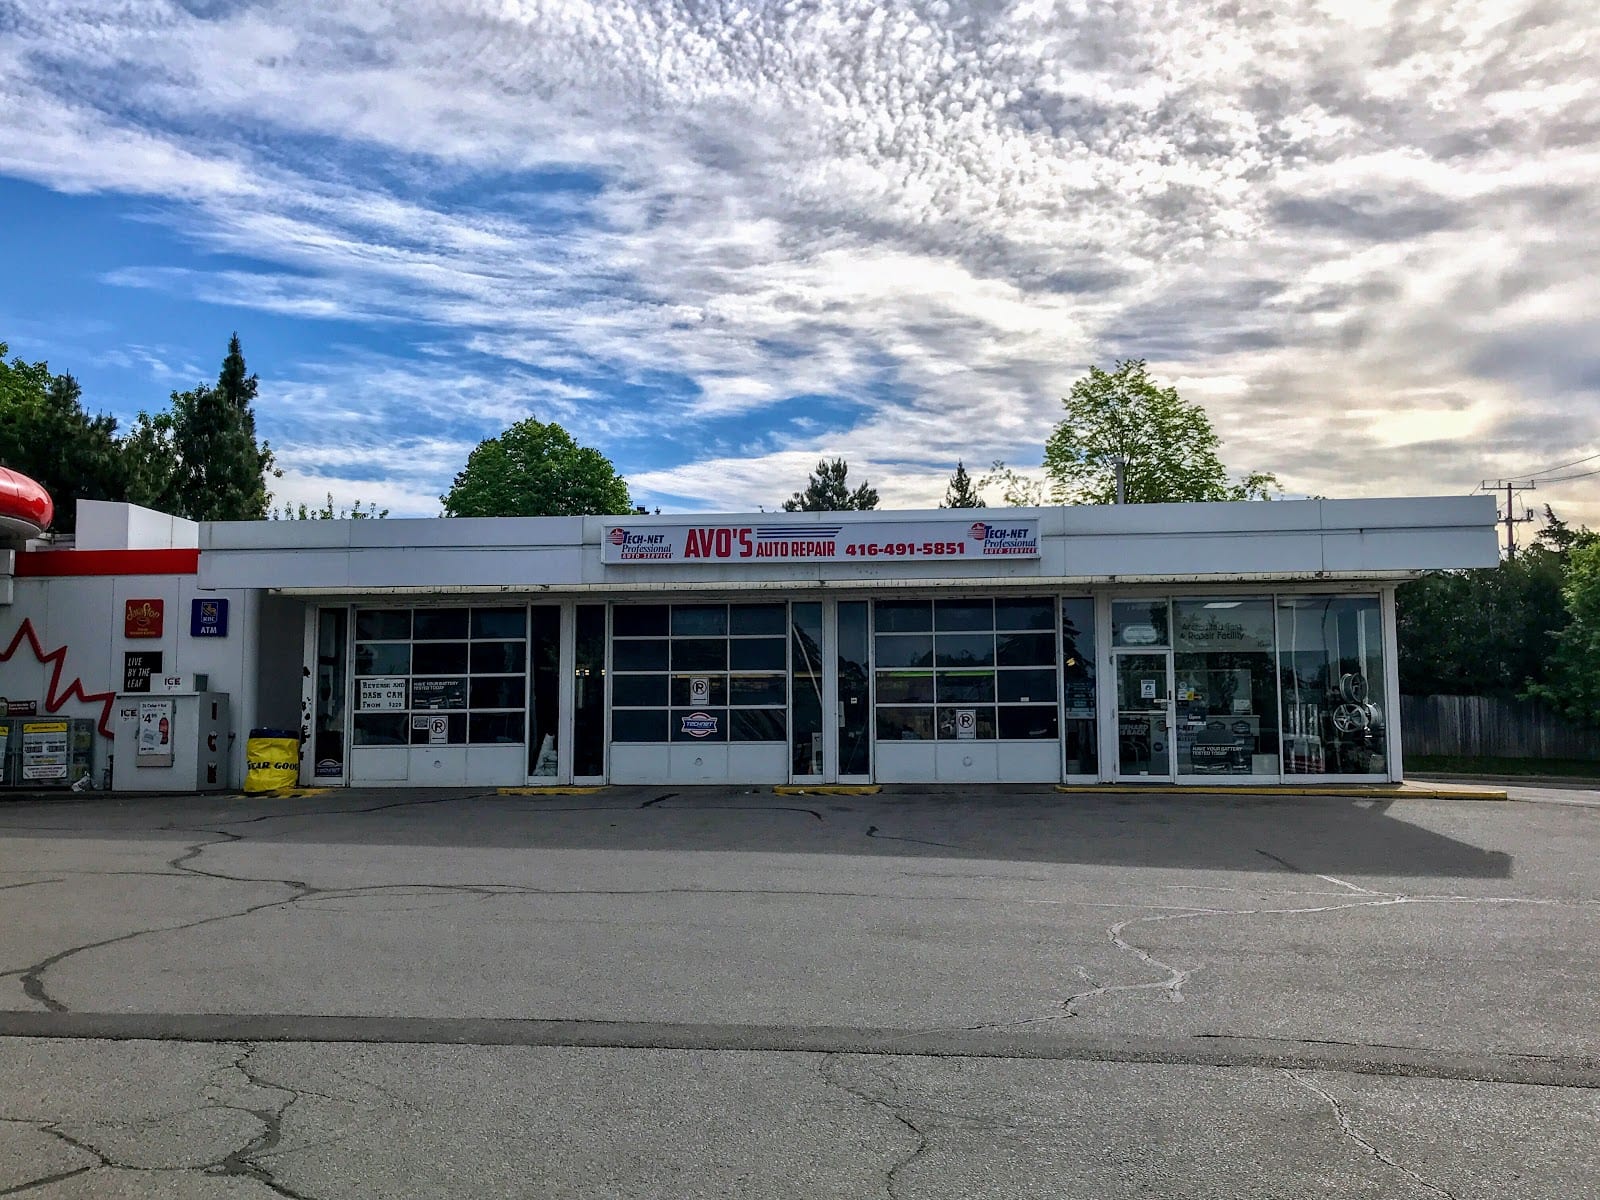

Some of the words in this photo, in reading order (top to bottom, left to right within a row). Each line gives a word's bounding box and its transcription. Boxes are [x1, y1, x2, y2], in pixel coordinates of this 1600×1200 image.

[984, 526, 1029, 538] TECH-NET
[622, 531, 664, 544] TECH-NET
[684, 528, 753, 557] AVO'S
[984, 538, 1036, 548] Professional
[622, 544, 671, 553] Professional
[756, 541, 789, 556] AUTO
[791, 541, 836, 556] REPAIR
[845, 542, 965, 556] 416-491-5851
[200, 626, 217, 634] ATM
[1188, 632, 1214, 640] Repair
[1217, 631, 1244, 640] Facility
[128, 657, 144, 666] LIVE
[128, 668, 137, 677] BY
[139, 667, 151, 677] THE
[128, 678, 144, 688] LEAF
[164, 677, 181, 686] ICE
[121, 709, 137, 717] ICE
